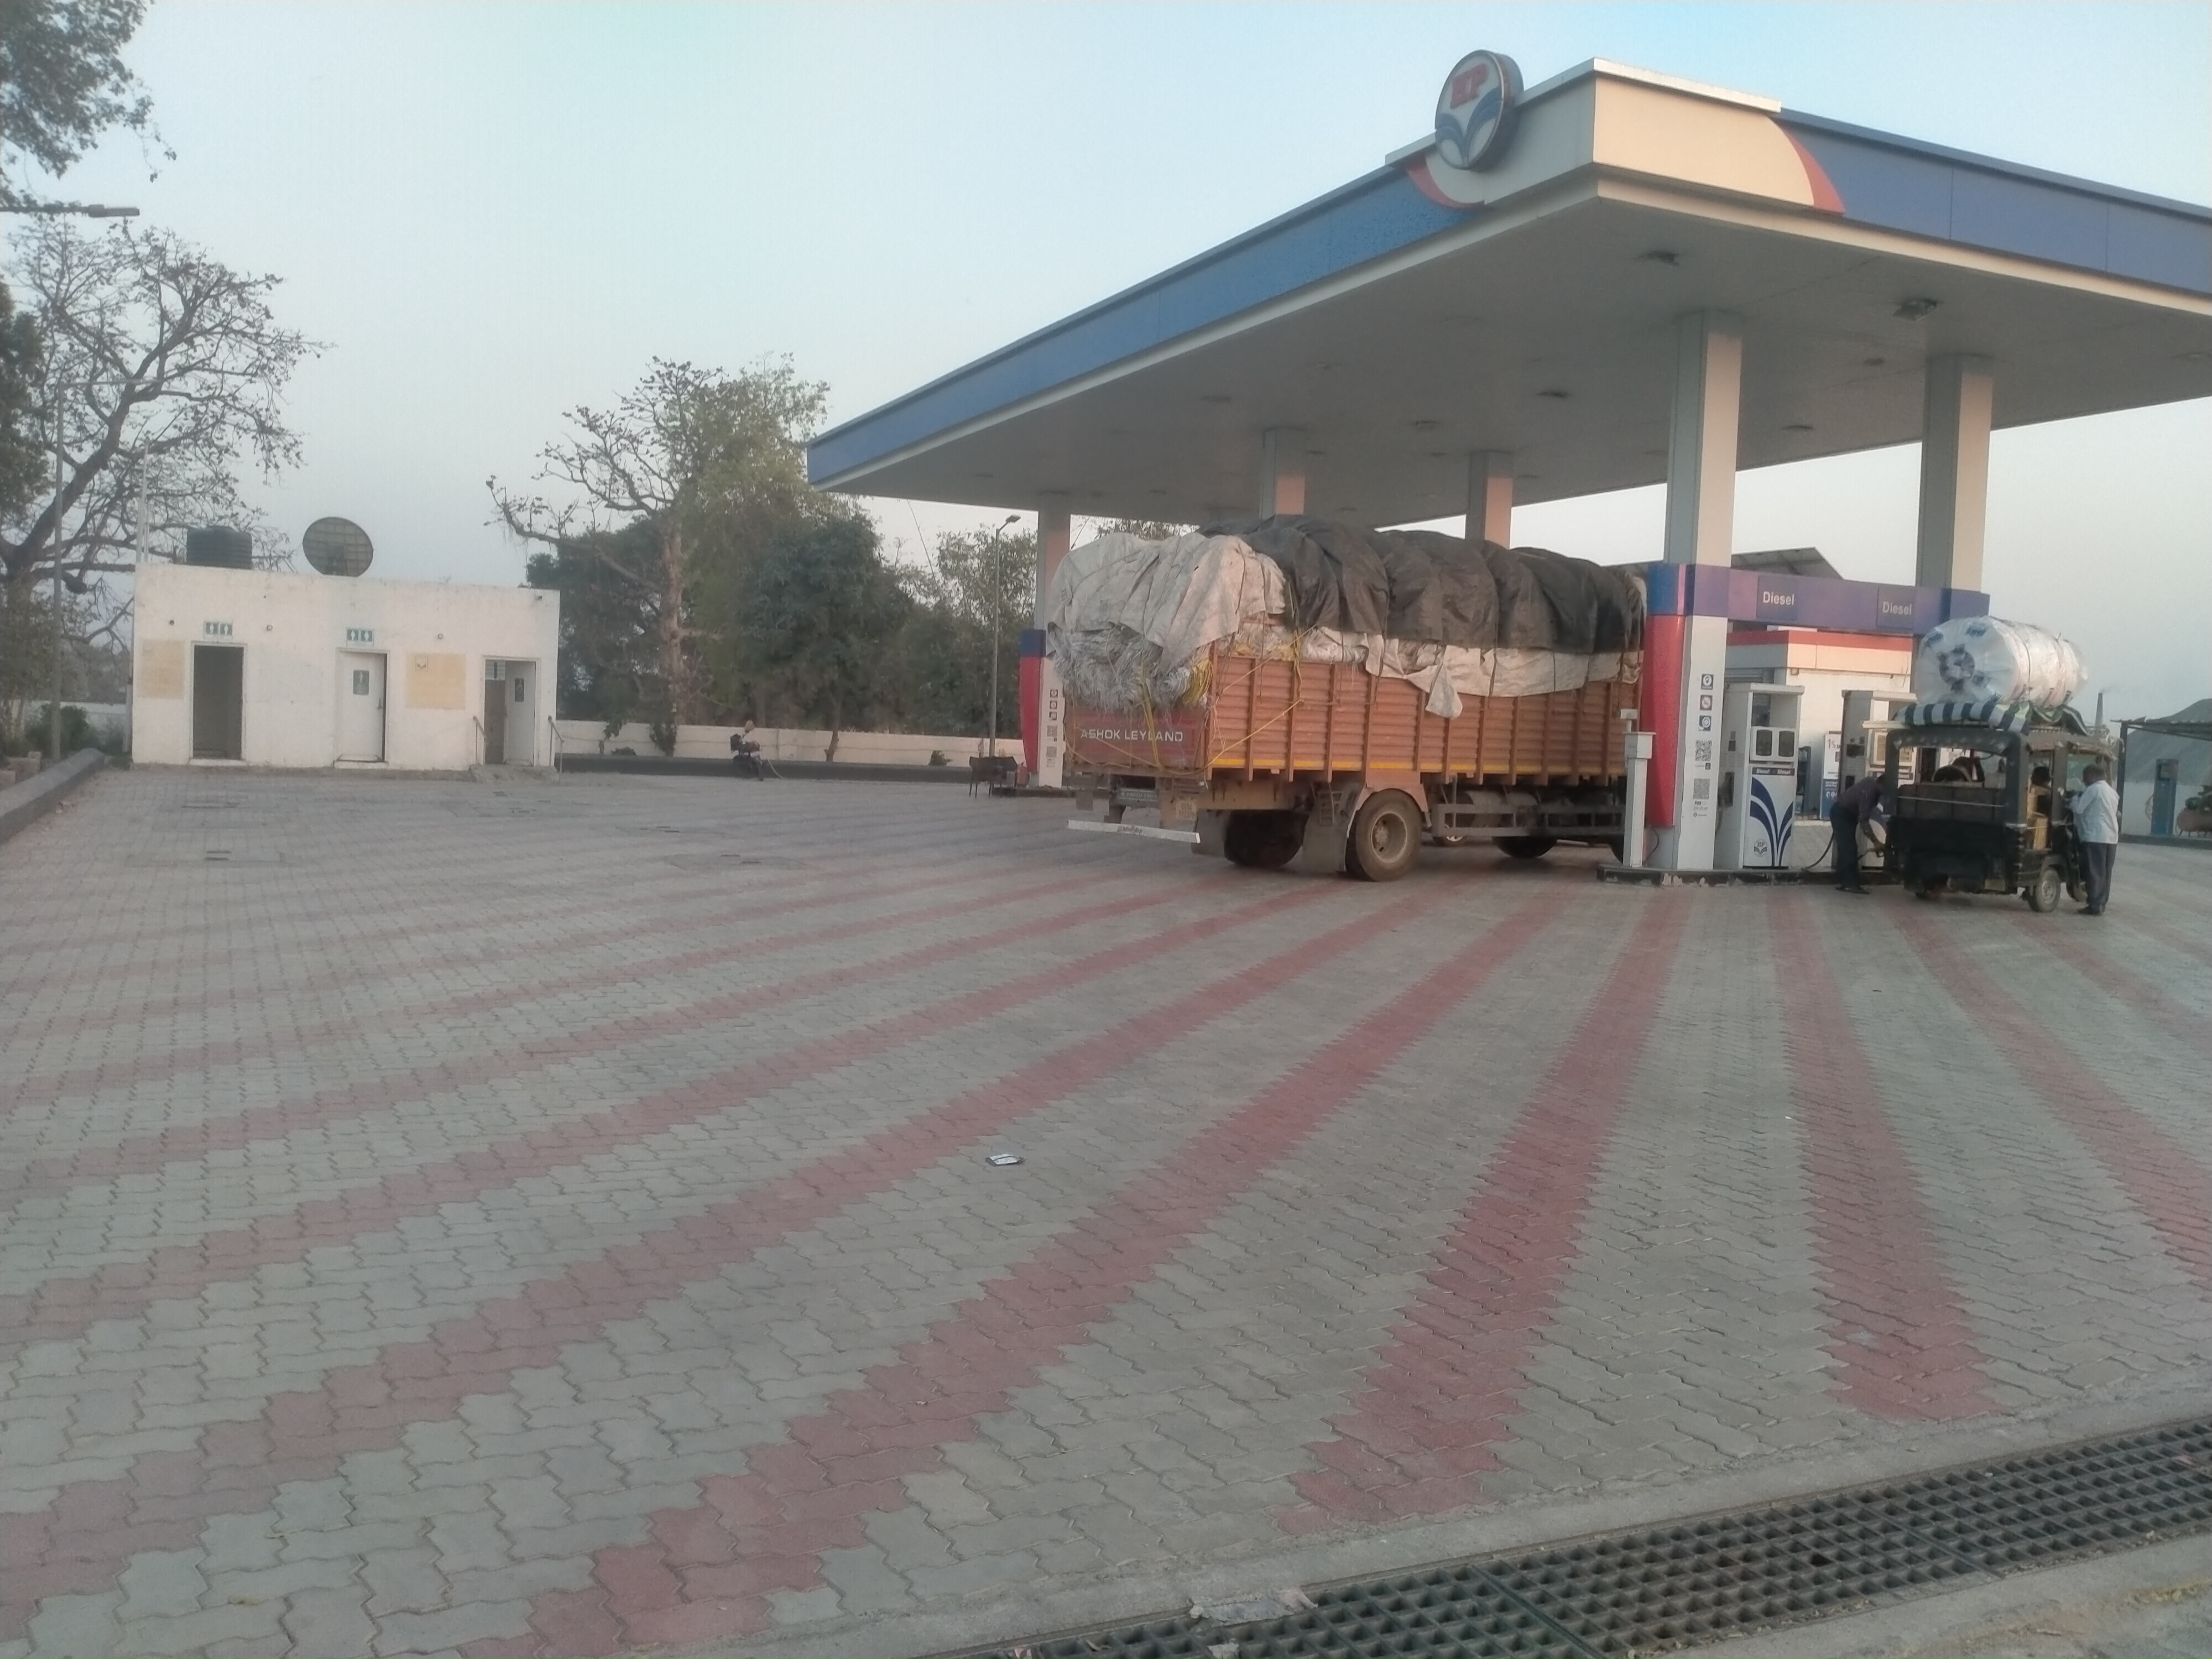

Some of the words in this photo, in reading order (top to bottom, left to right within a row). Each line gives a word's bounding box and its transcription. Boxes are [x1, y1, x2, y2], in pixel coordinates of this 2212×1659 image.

[1763, 591, 1794, 606] Diesel
[1882, 601, 1912, 615] Diesel
[1080, 728, 1120, 740] ASHOK
[1124, 729, 1183, 742] LEYLAND
